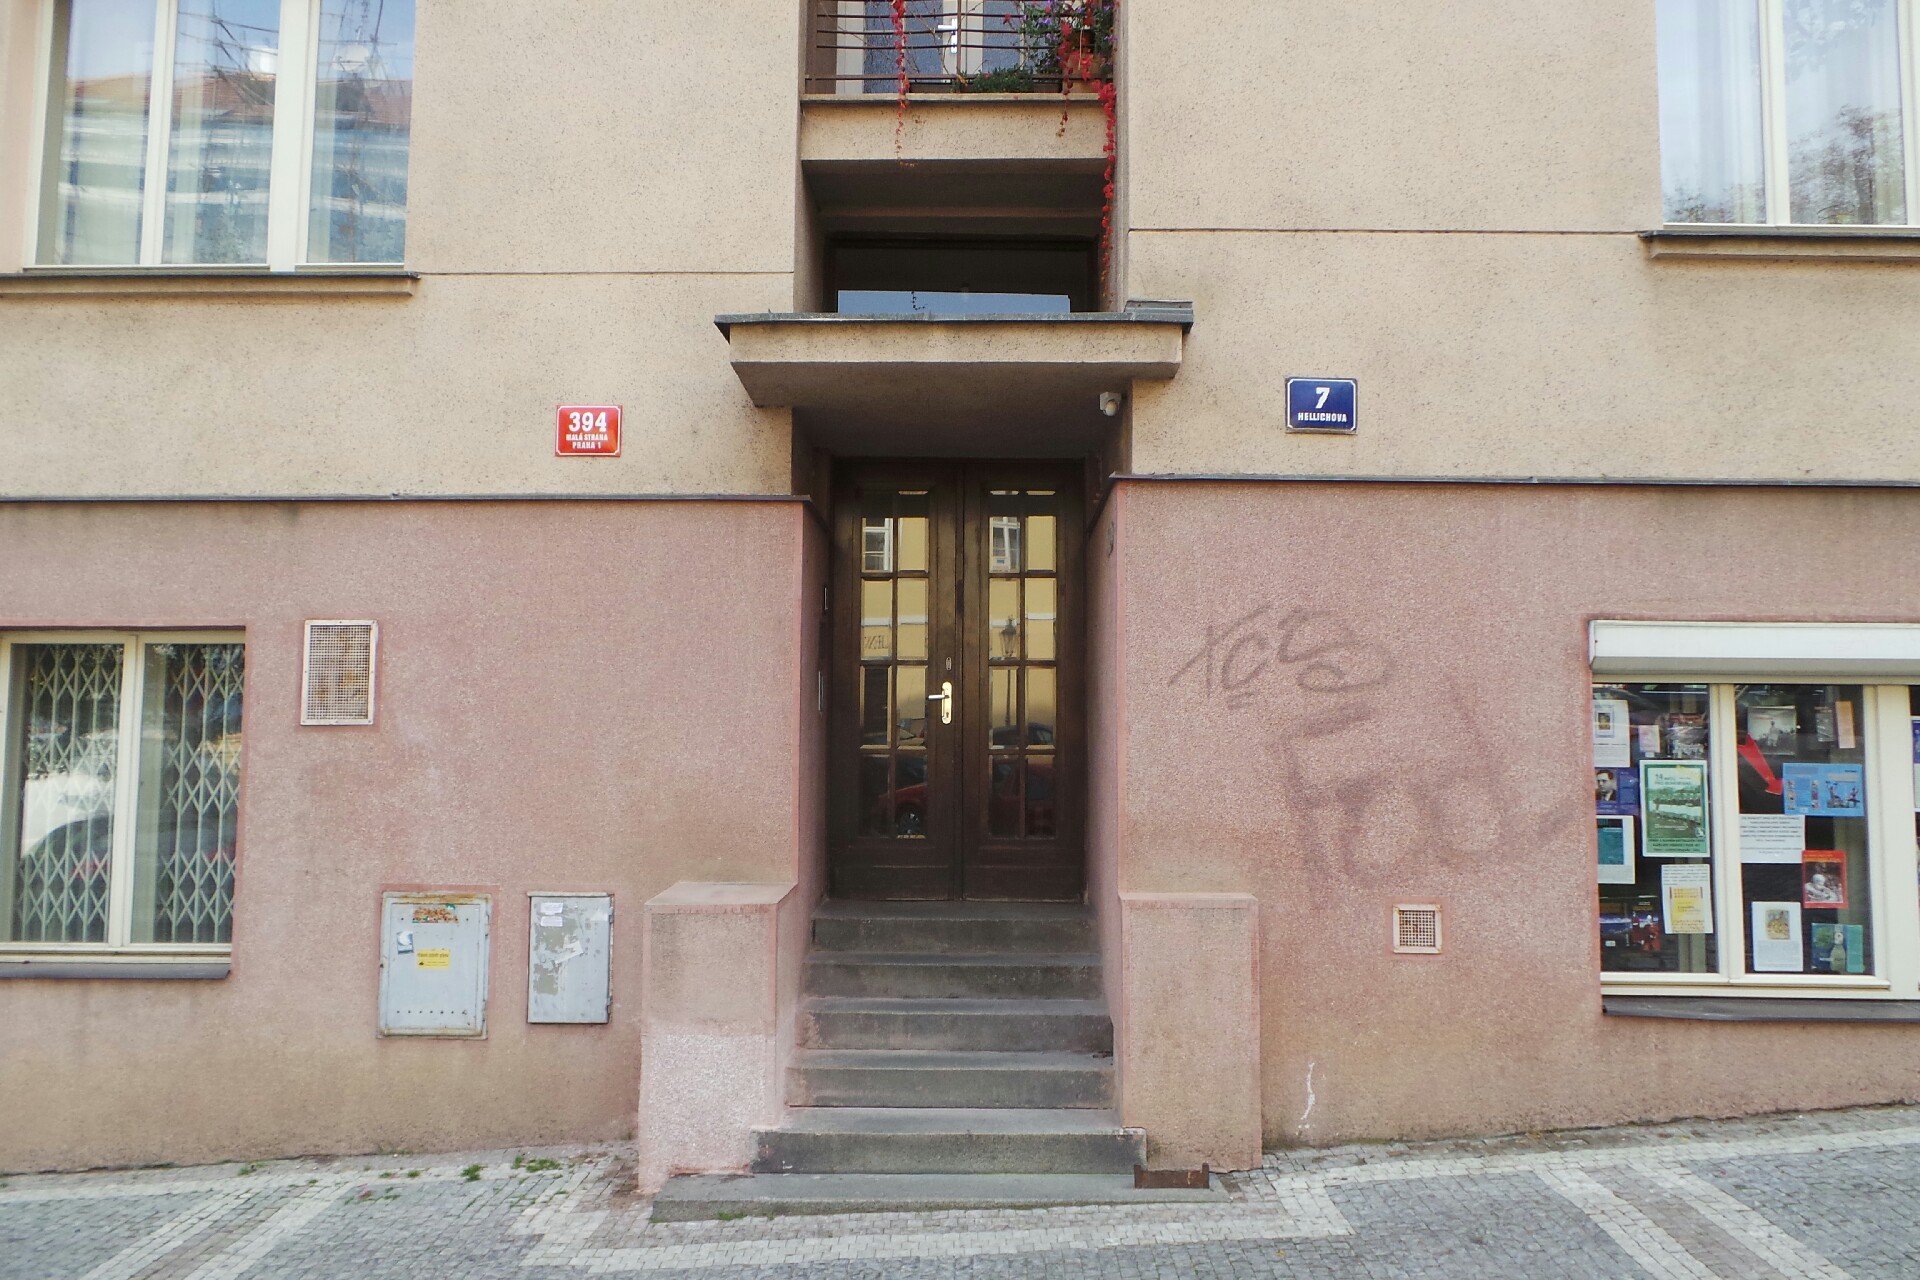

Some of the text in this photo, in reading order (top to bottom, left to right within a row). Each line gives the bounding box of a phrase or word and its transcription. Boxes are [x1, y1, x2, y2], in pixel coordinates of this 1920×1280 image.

[1316, 387, 1330, 408] 7
[568, 412, 606, 432] 394
[1297, 412, 1347, 422] HELLICHOVA
[565, 432, 608, 441] MALÁ STRANA
[572, 441, 596, 449] PRAHA
